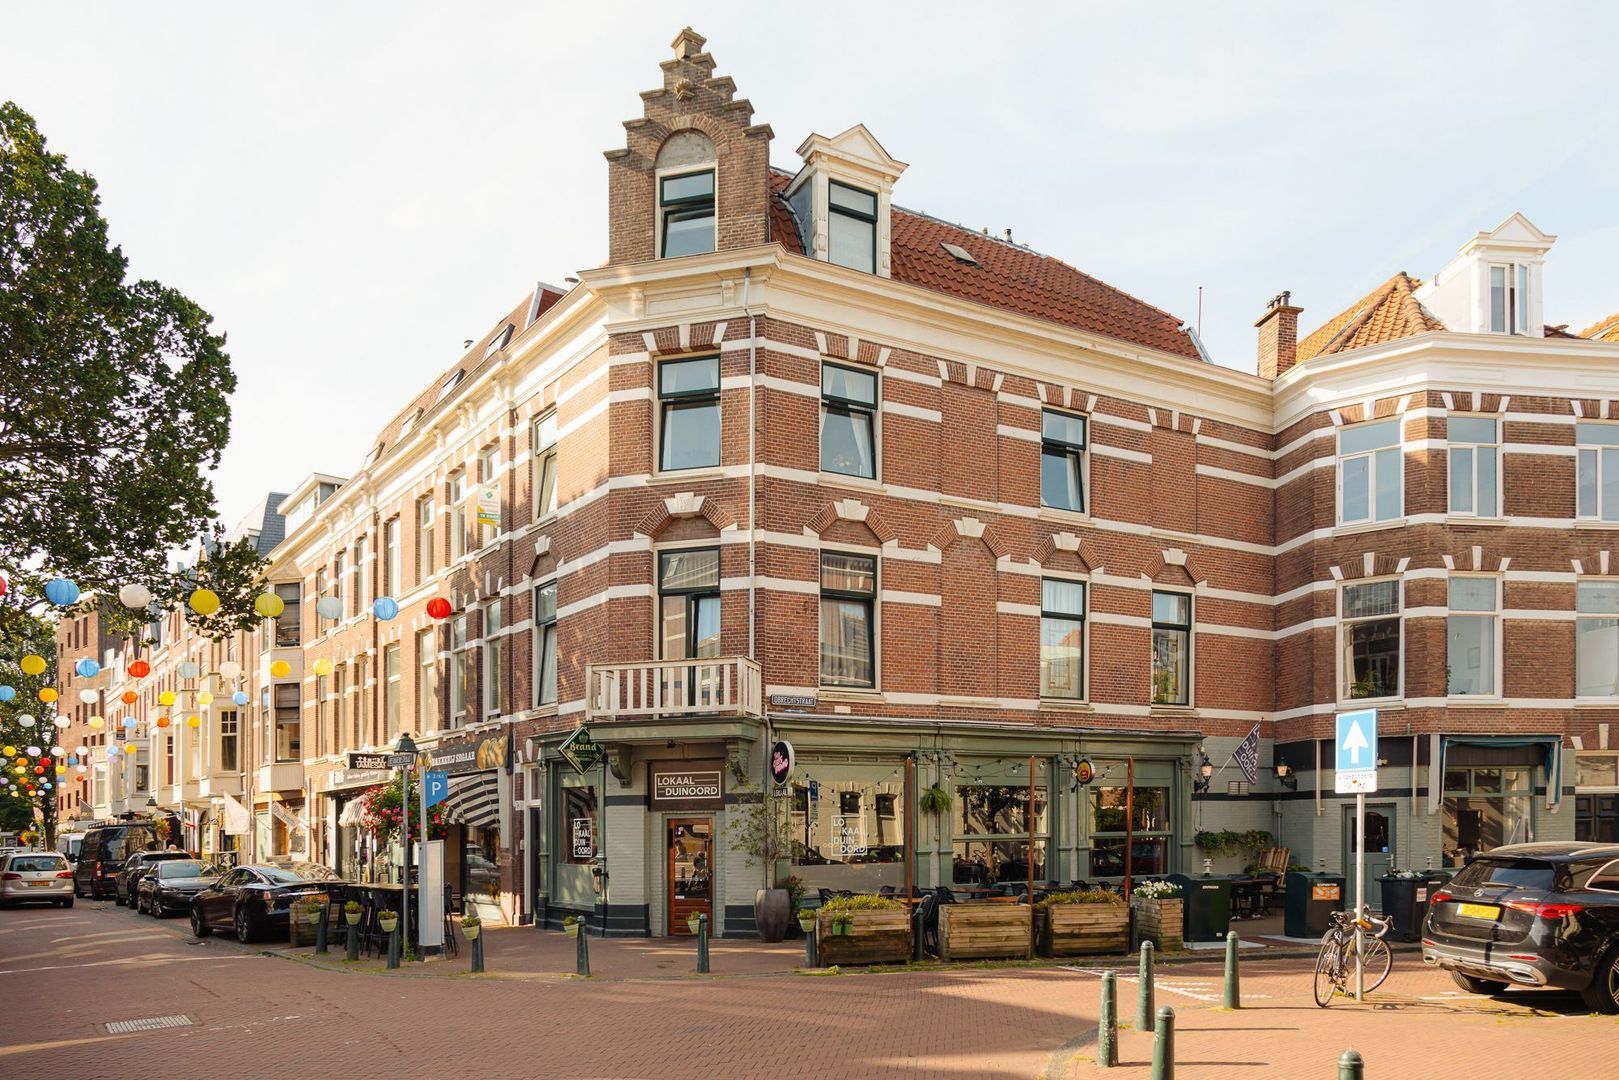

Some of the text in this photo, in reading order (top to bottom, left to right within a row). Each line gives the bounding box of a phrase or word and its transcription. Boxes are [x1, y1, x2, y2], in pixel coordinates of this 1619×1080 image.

[570, 741, 597, 751] Brand
[657, 776, 695, 786] LOKAAL
[432, 781, 442, 796] P
[665, 787, 718, 796] DUINOORD
[574, 821, 581, 829] LO
[833, 818, 845, 827] LO
[833, 836, 855, 844] DUIN
[577, 846, 591, 855] OORD
[840, 844, 865, 853] OORD
